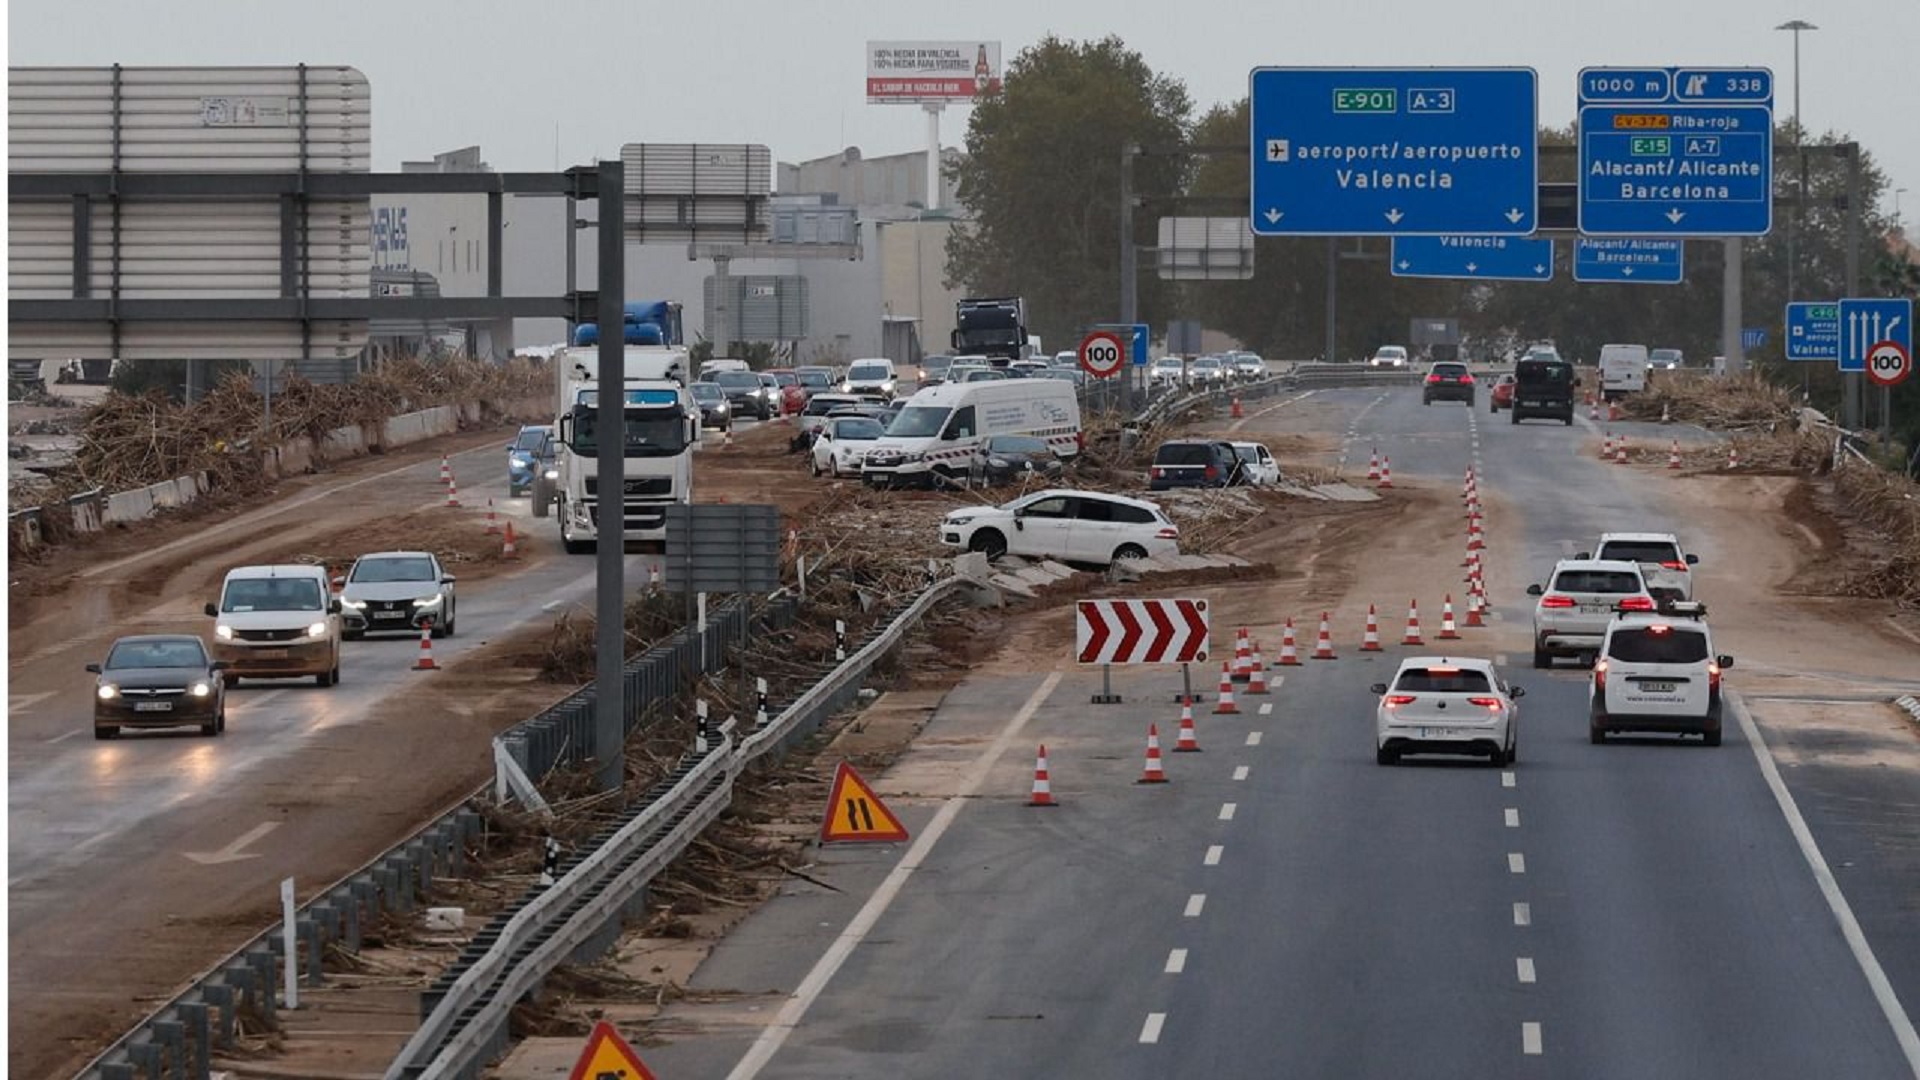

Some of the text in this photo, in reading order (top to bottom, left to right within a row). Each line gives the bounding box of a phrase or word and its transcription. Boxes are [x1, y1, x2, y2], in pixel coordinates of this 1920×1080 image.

[1590, 79, 1659, 91] 1000 m
[1727, 79, 1761, 91] 338
[1337, 93, 1392, 108] E-901
[1413, 93, 1450, 108] A-3
[1673, 115, 1739, 130] Riba-roja
[1634, 140, 1666, 152] E-15
[1688, 140, 1716, 152] A-7
[1337, 169, 1452, 188] Valencia
[1621, 183, 1728, 198] Barcelona
[1440, 236, 1506, 248] Valencia
[1597, 252, 1659, 263] Barcelona
[1087, 347, 1117, 362] 100
[1872, 355, 1902, 370] 100
